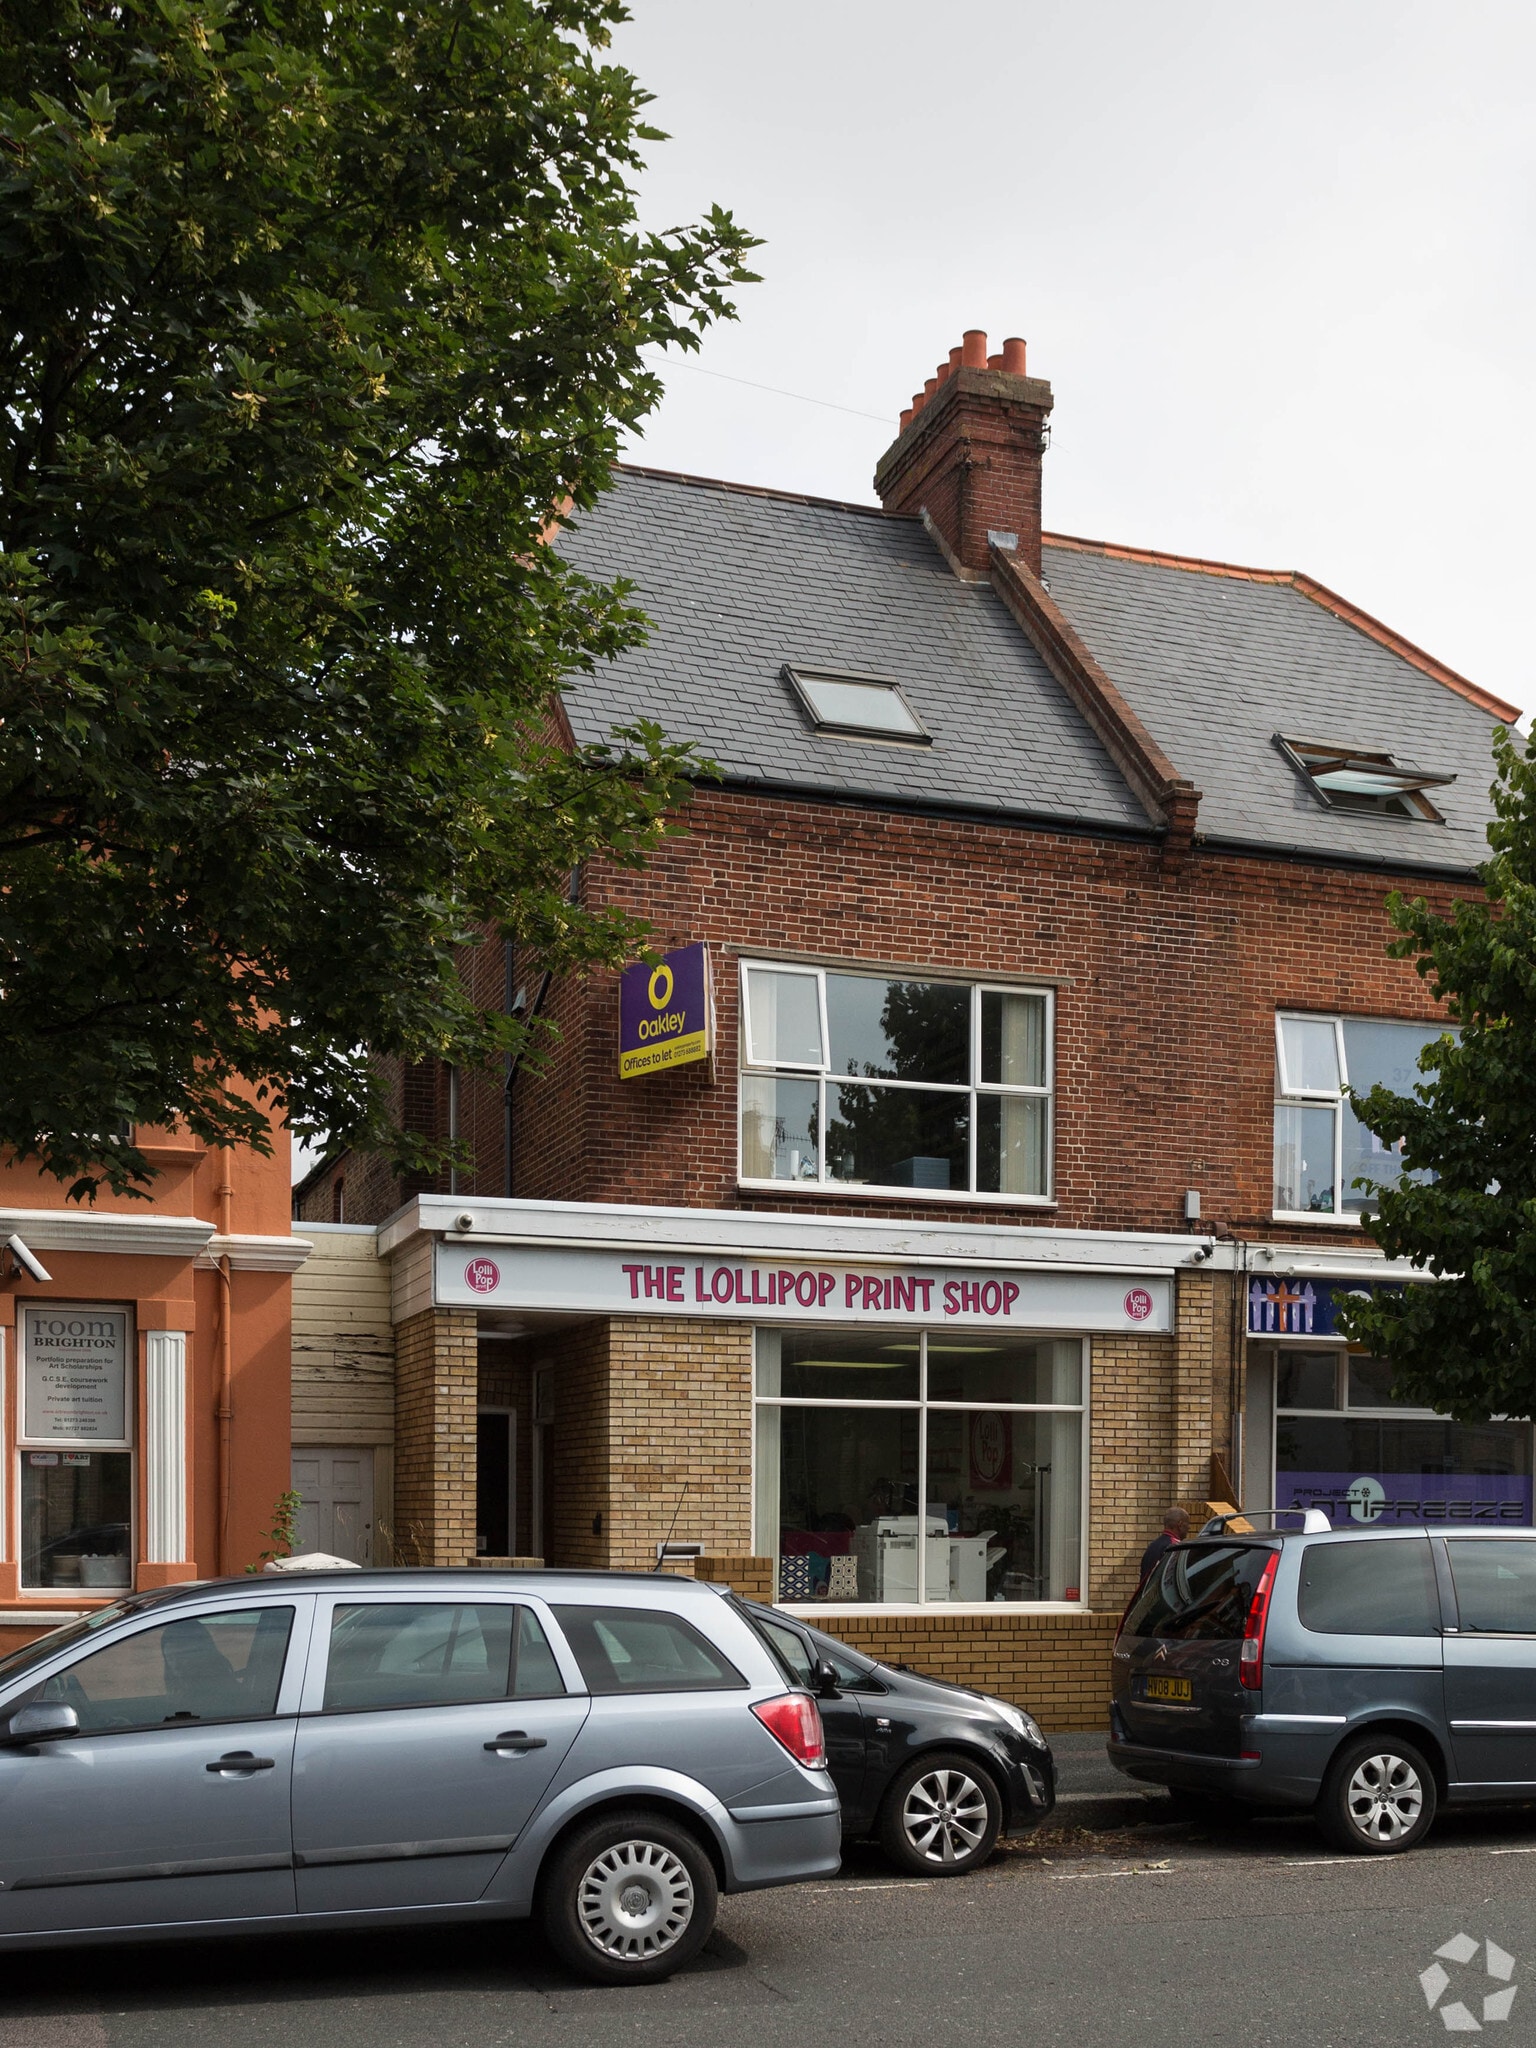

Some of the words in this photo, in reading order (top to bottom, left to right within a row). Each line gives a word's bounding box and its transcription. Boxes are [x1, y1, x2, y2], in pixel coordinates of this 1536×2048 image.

[638, 1010, 686, 1041] Oakley
[623, 1055, 651, 1072] Offices
[652, 1053, 661, 1064] to
[661, 1048, 673, 1062] let
[1392, 1068, 1412, 1083] 37
[473, 1261, 493, 1275] Lolli
[475, 1273, 494, 1291] Pop
[621, 1264, 685, 1302] THE
[695, 1265, 836, 1308] LOLLIPOP
[845, 1274, 935, 1312] PRINT
[942, 1279, 1020, 1316] SHOP
[1130, 1292, 1147, 1304] Lolli
[1132, 1302, 1148, 1318] Pop
[33, 1319, 117, 1338] room
[33, 1337, 116, 1349] BRIGHTON
[36, 1355, 64, 1363] Portfolio
[66, 1357, 103, 1365] preparation
[60, 1363, 103, 1371] Scholarships
[55, 1382, 97, 1390] development
[979, 1419, 998, 1441] Lolli
[982, 1440, 998, 1476] Pop
[1293, 1487, 1360, 1497] PROJECT
[1284, 1498, 1523, 1518] ANTIFREEZE
[1147, 1678, 1169, 1696] HV08
[1171, 1681, 1190, 1698] JUJ
